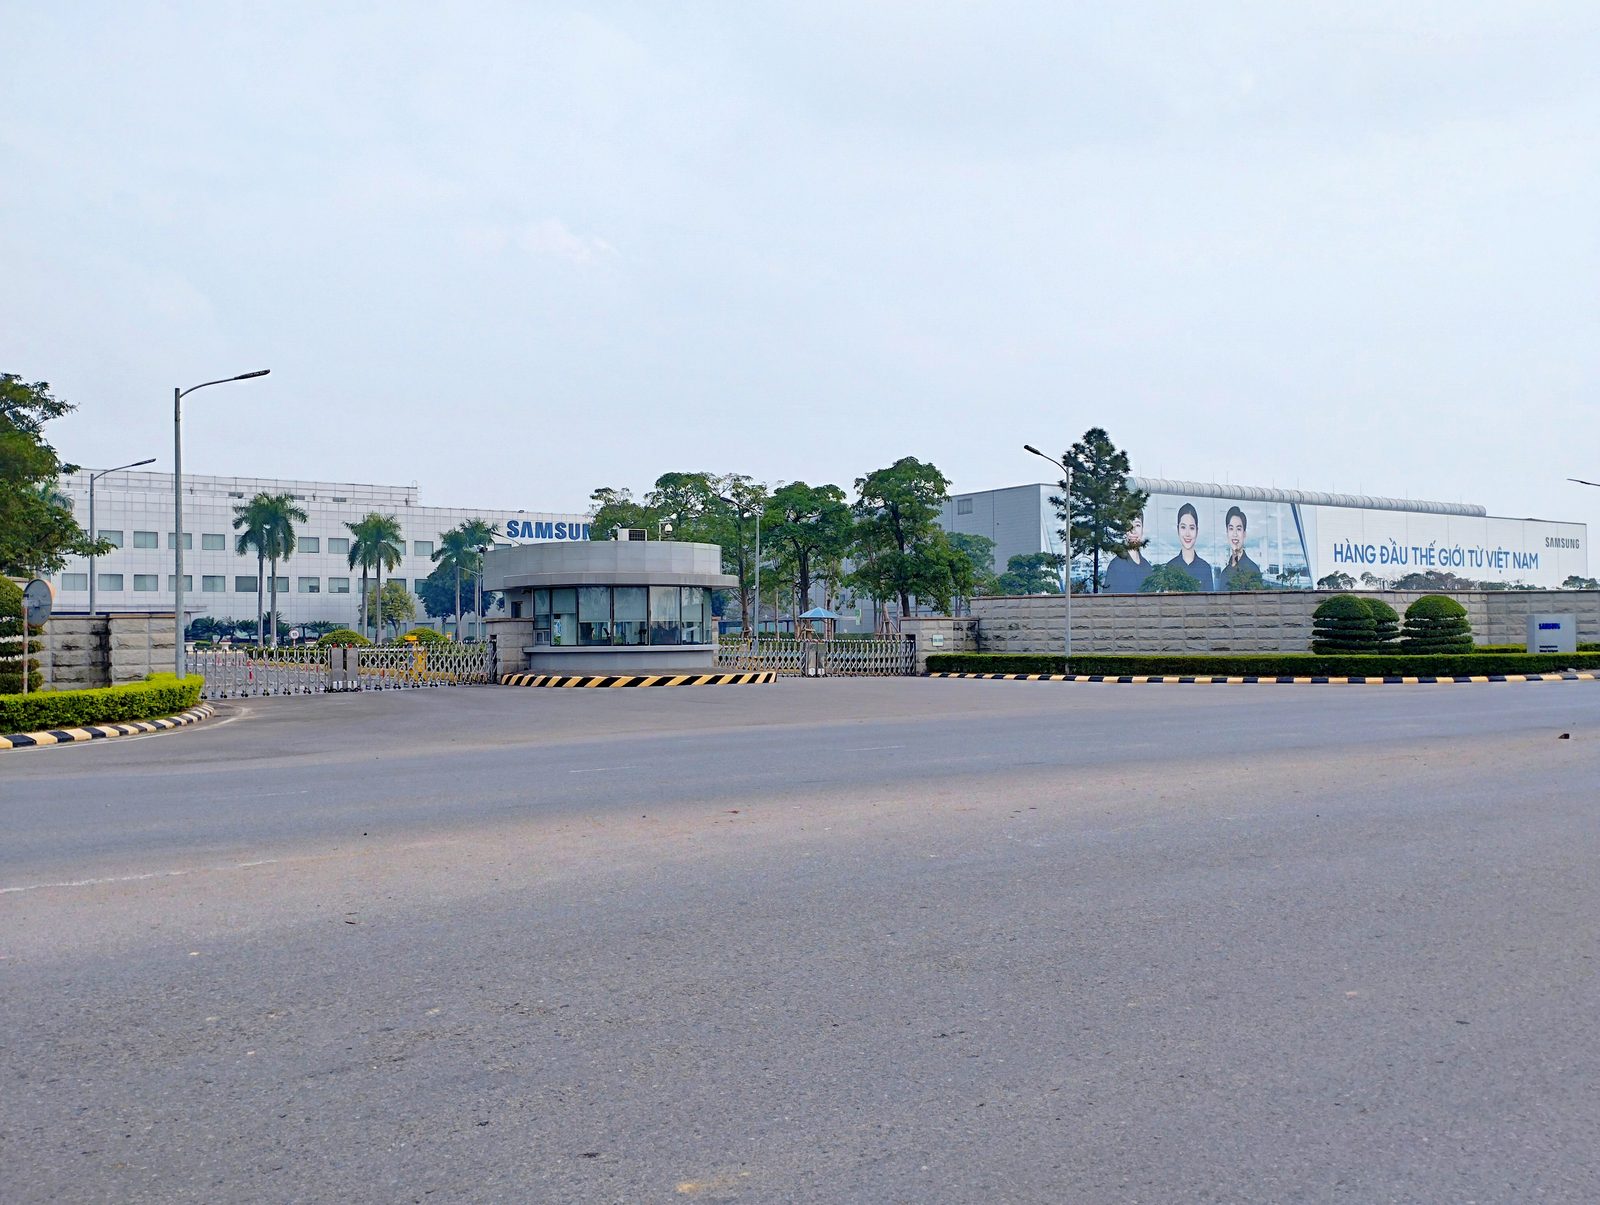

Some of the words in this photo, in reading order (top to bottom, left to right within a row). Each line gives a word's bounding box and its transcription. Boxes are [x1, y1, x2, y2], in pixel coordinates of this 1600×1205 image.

[506, 520, 591, 541] SAMSUN
[1545, 537, 1580, 549] SAMSUNG
[1334, 538, 1376, 564] HÀNG
[1380, 537, 1408, 565] ĐẦU
[1412, 540, 1436, 566] THẾ
[1438, 544, 1465, 567] GIỚI
[1468, 545, 1484, 567] TỪ
[1486, 546, 1510, 574] VIỆT
[1513, 552, 1539, 569] NAM
